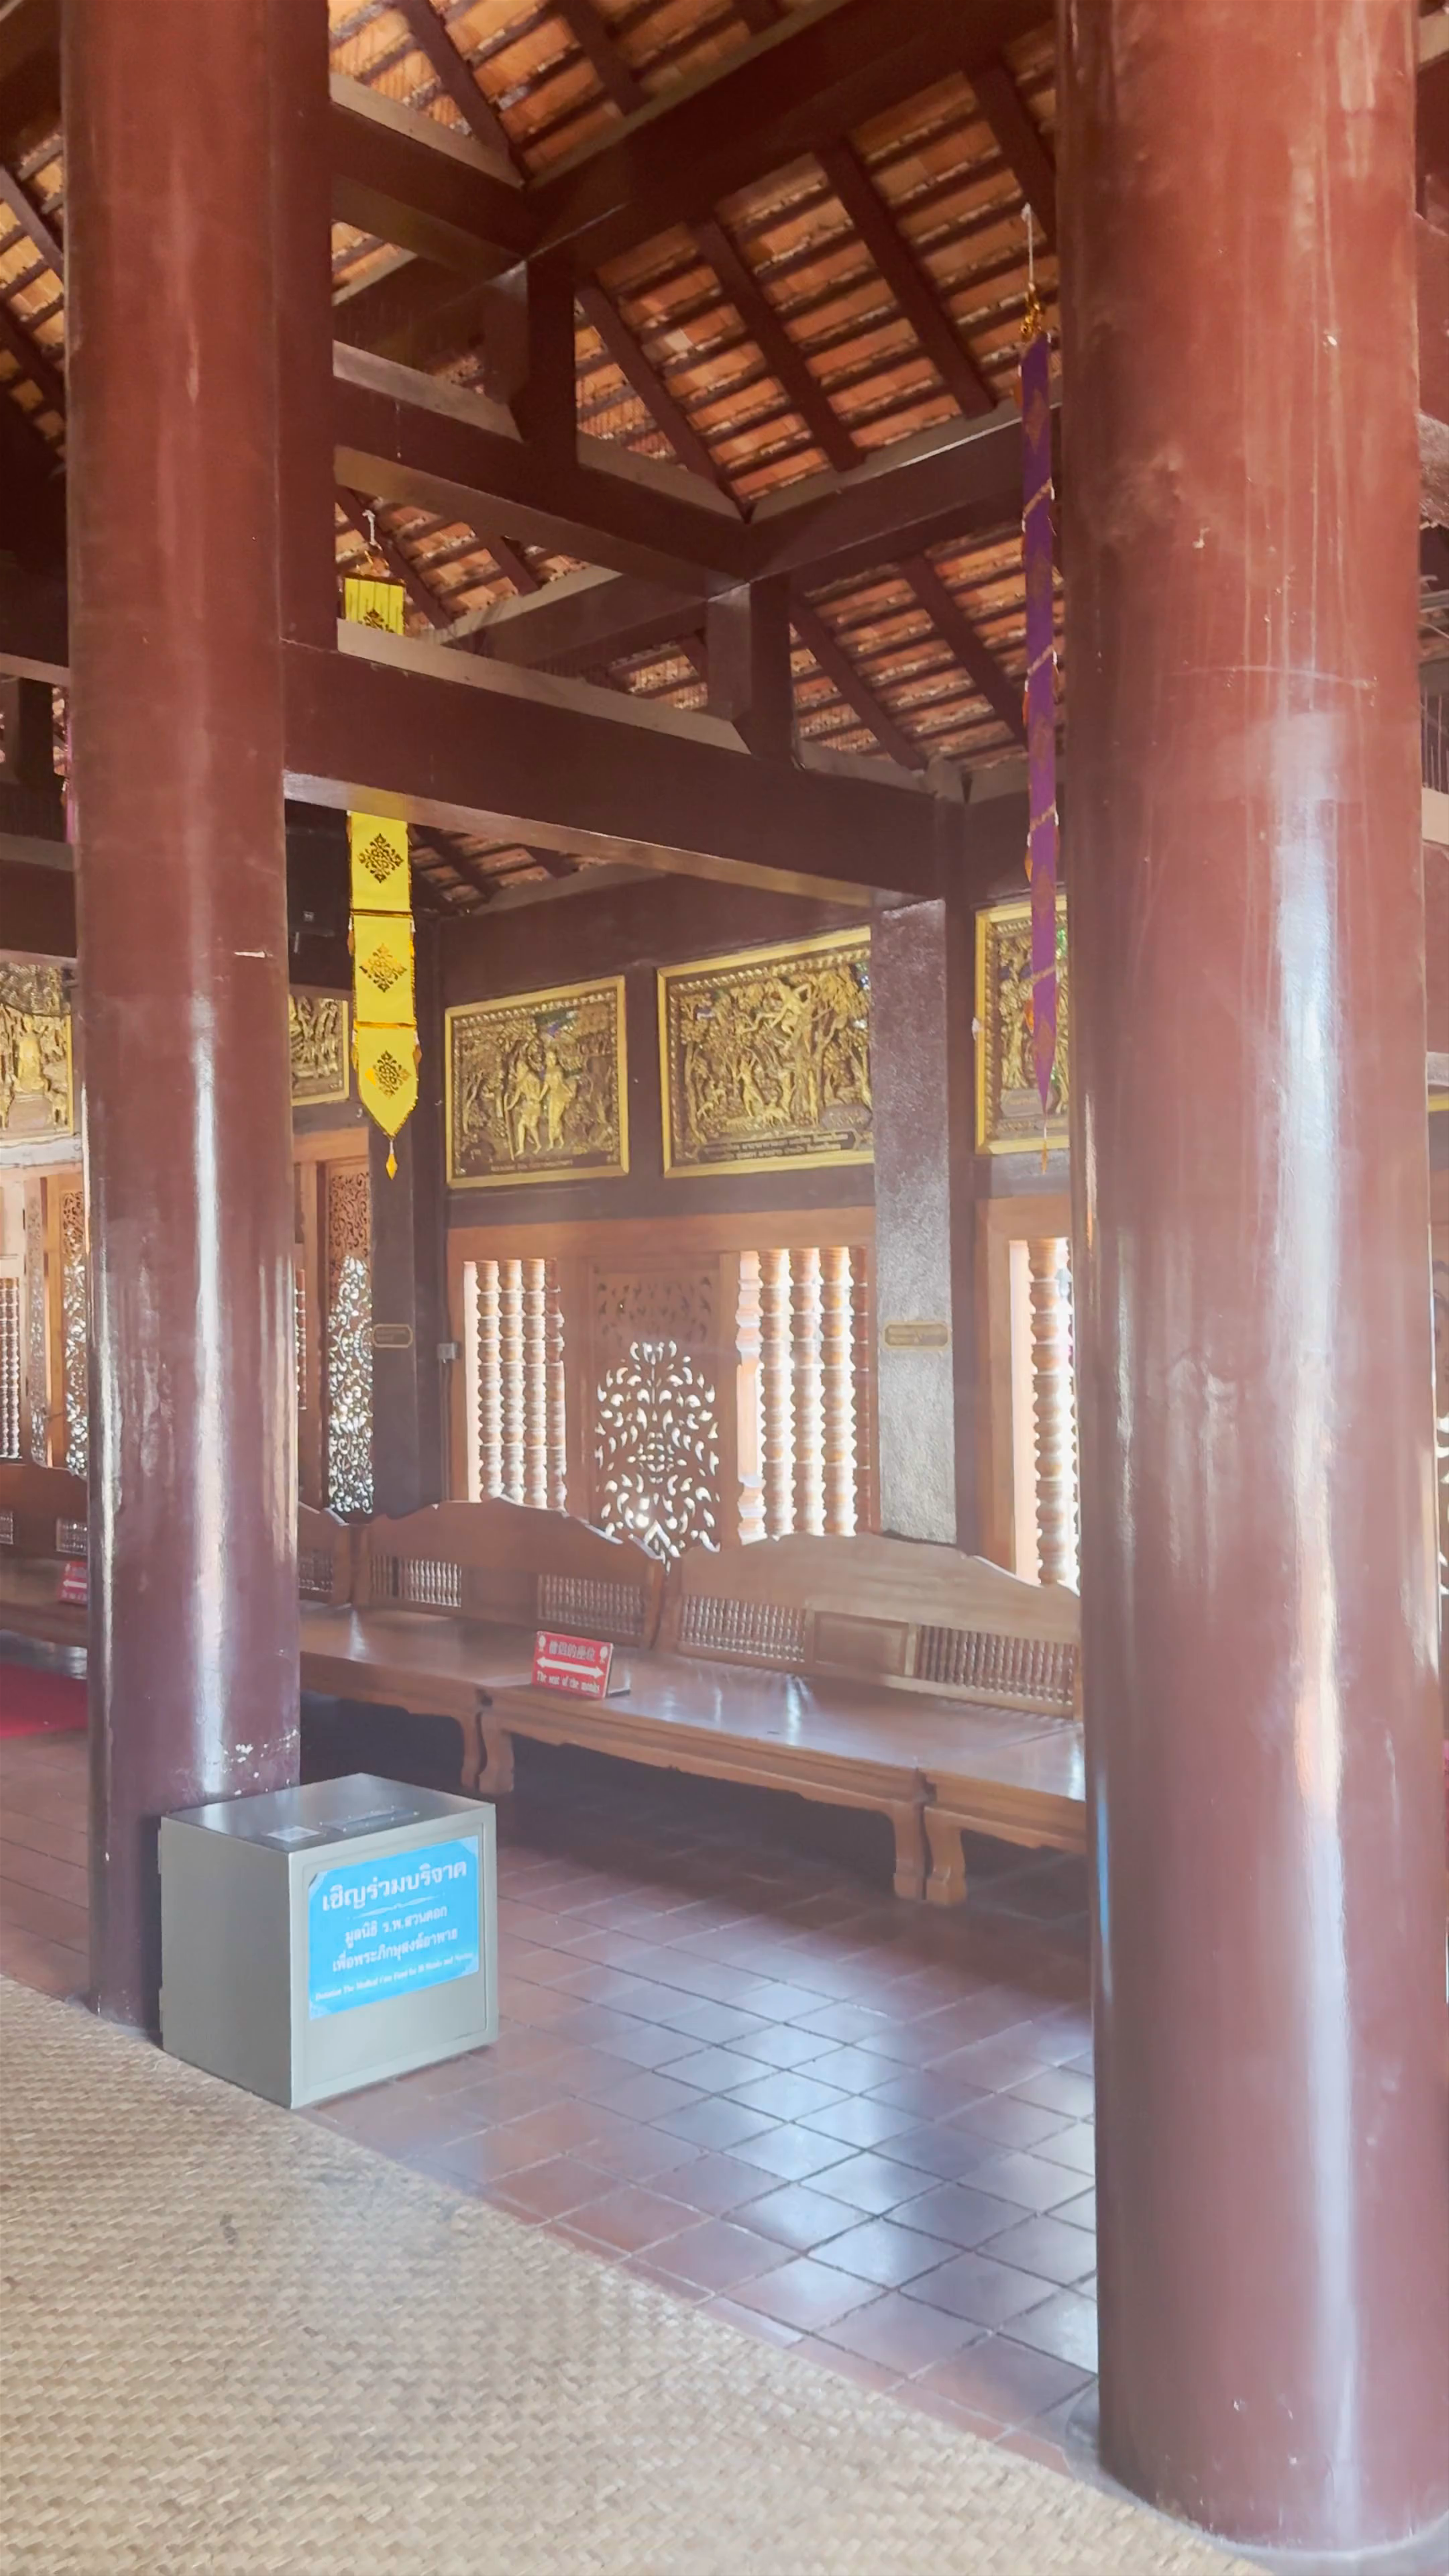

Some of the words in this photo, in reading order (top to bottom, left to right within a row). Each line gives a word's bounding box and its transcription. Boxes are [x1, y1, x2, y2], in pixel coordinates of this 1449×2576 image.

[537, 1670, 546, 1682] The
[323, 1861, 467, 1911] เชิญร่วมบริจาค
[345, 1920, 377, 1949] มูลนิธิ
